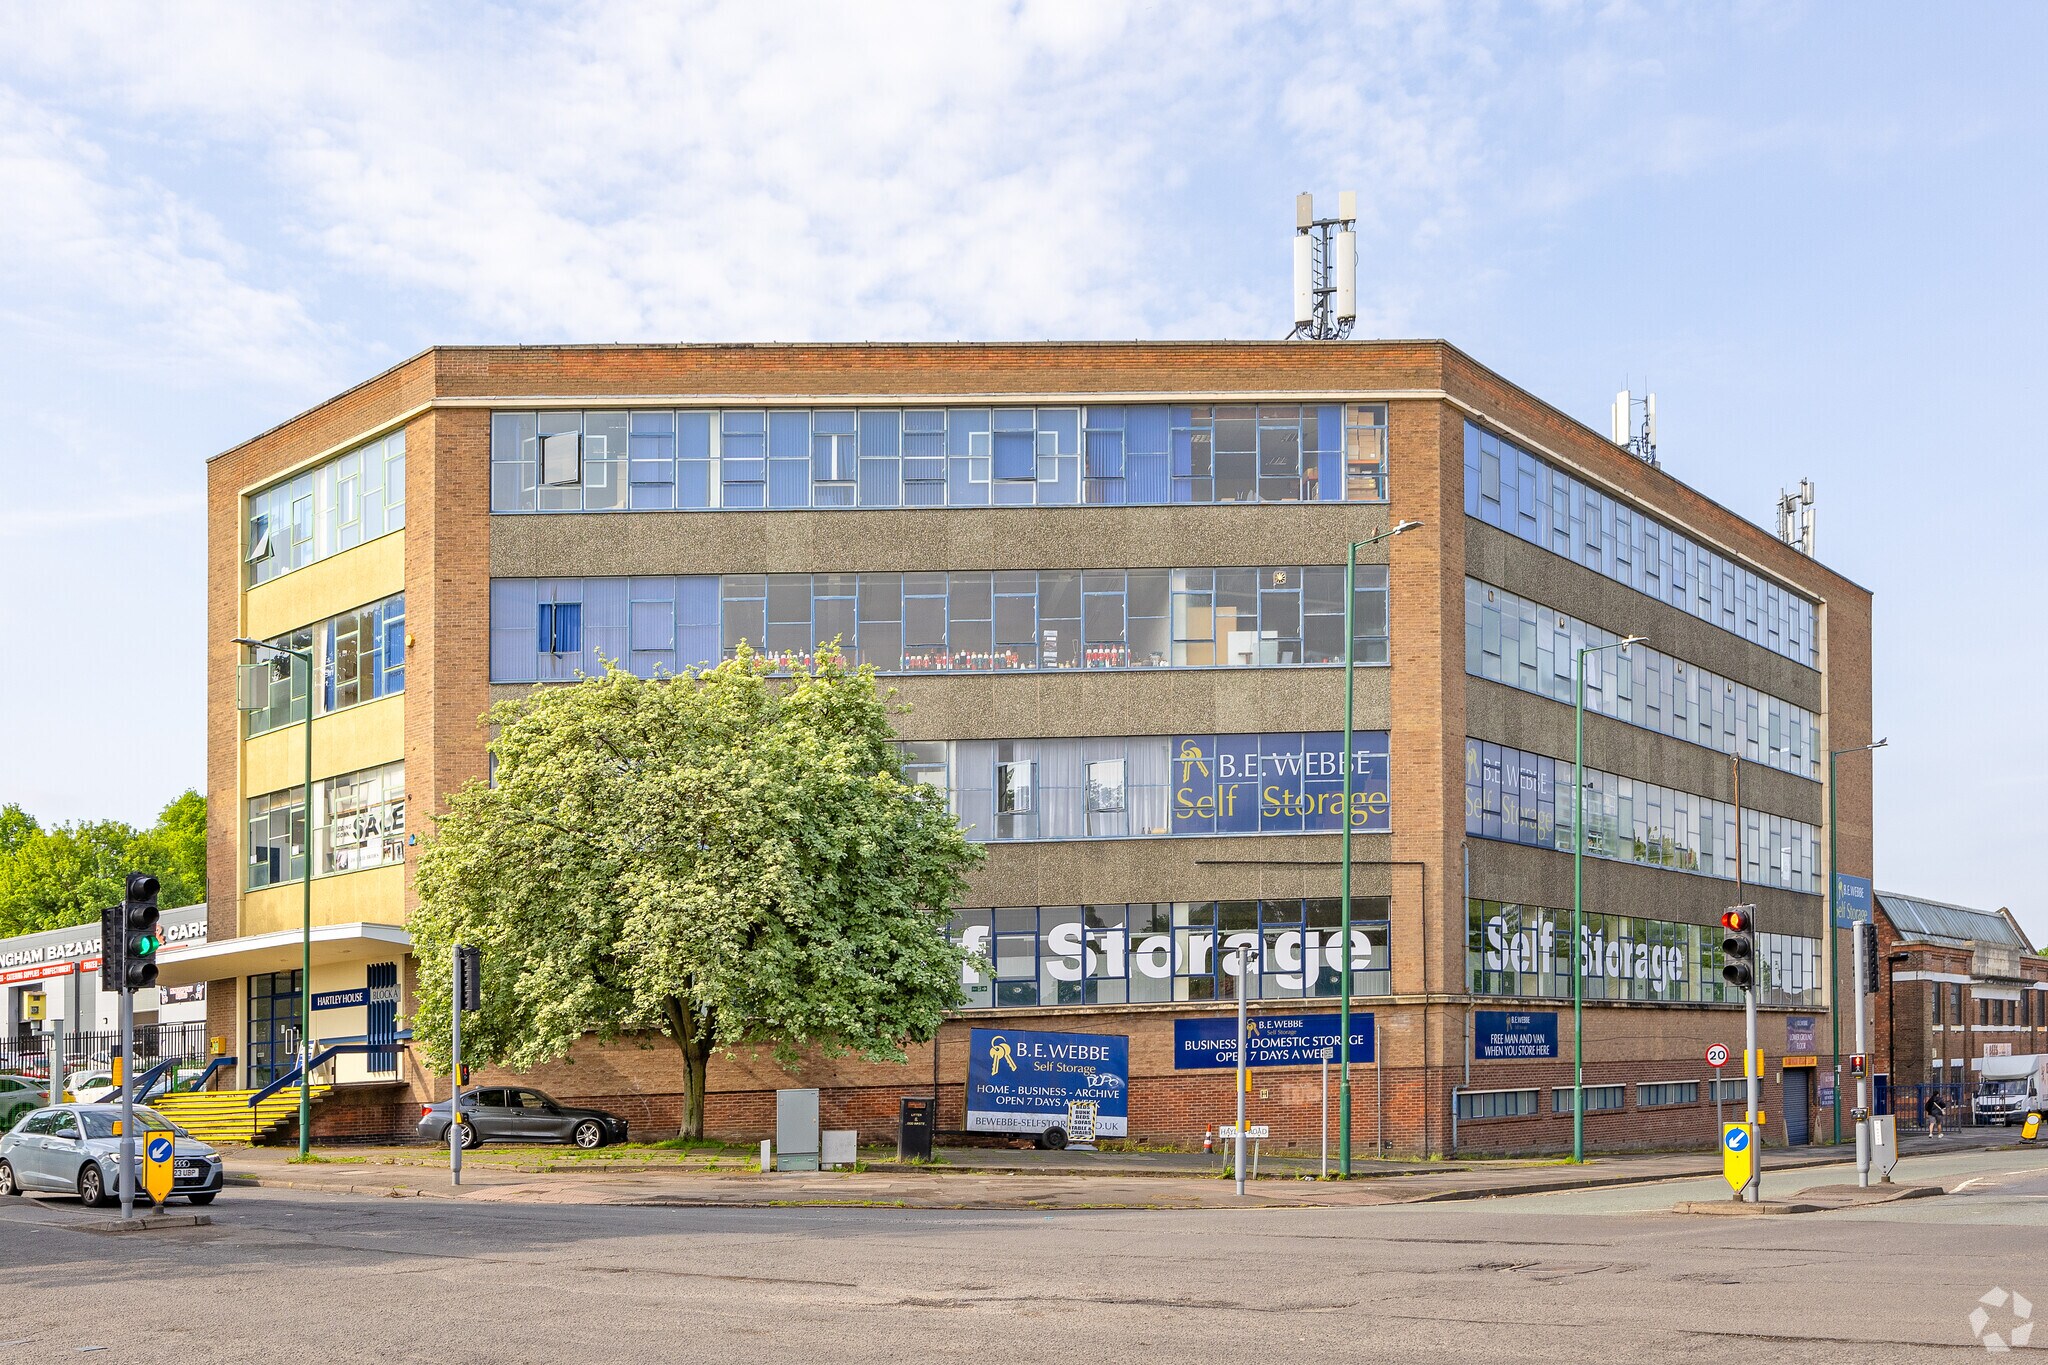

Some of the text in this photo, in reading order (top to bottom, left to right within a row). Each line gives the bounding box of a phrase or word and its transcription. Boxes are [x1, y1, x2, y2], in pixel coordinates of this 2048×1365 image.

[1176, 784, 1387, 826] Self Storage
[1465, 787, 1553, 840] Self Storage
[352, 804, 404, 840] SALE
[1847, 902, 1868, 921] Storage
[47, 938, 102, 960] BAZAAR
[1046, 922, 1372, 990] Storage
[1487, 915, 1683, 993] Self Storage
[317, 992, 363, 1006] HARTLEY HOUSE
[373, 989, 399, 1000] BLOCK A
[1185, 1039, 1237, 1050] BUSINESS
[1251, 1036, 1311, 1049] DOMESTIC
[1312, 1035, 1364, 1046] STORGE
[1490, 1033, 1545, 1044] FREE MAN AND VAN
[1216, 1051, 1247, 1062] OPE
[1250, 1051, 1257, 1061] 7
[1260, 1049, 1289, 1061] DAYS
[1292, 1049, 1300, 1059] A
[1302, 1048, 1324, 1059] WEE
[1484, 1044, 1550, 1056] WHEN YOU STORE HERE
[1709, 1051, 1726, 1060] 20
[1034, 1061, 1096, 1076] Self Storage
[977, 1084, 1010, 1095] HOME
[1018, 1086, 1067, 1097] BUSINESS
[1075, 1088, 1120, 1099] ARCHIVE
[996, 1096, 1024, 1106] OPEN
[1026, 1097, 1032, 1106] 7
[1034, 1097, 1061, 1107] DAYS
[975, 1116, 1119, 1131] BEWEBBE-SELFSTORO.UK
[183, 1169, 196, 1177] UBP
